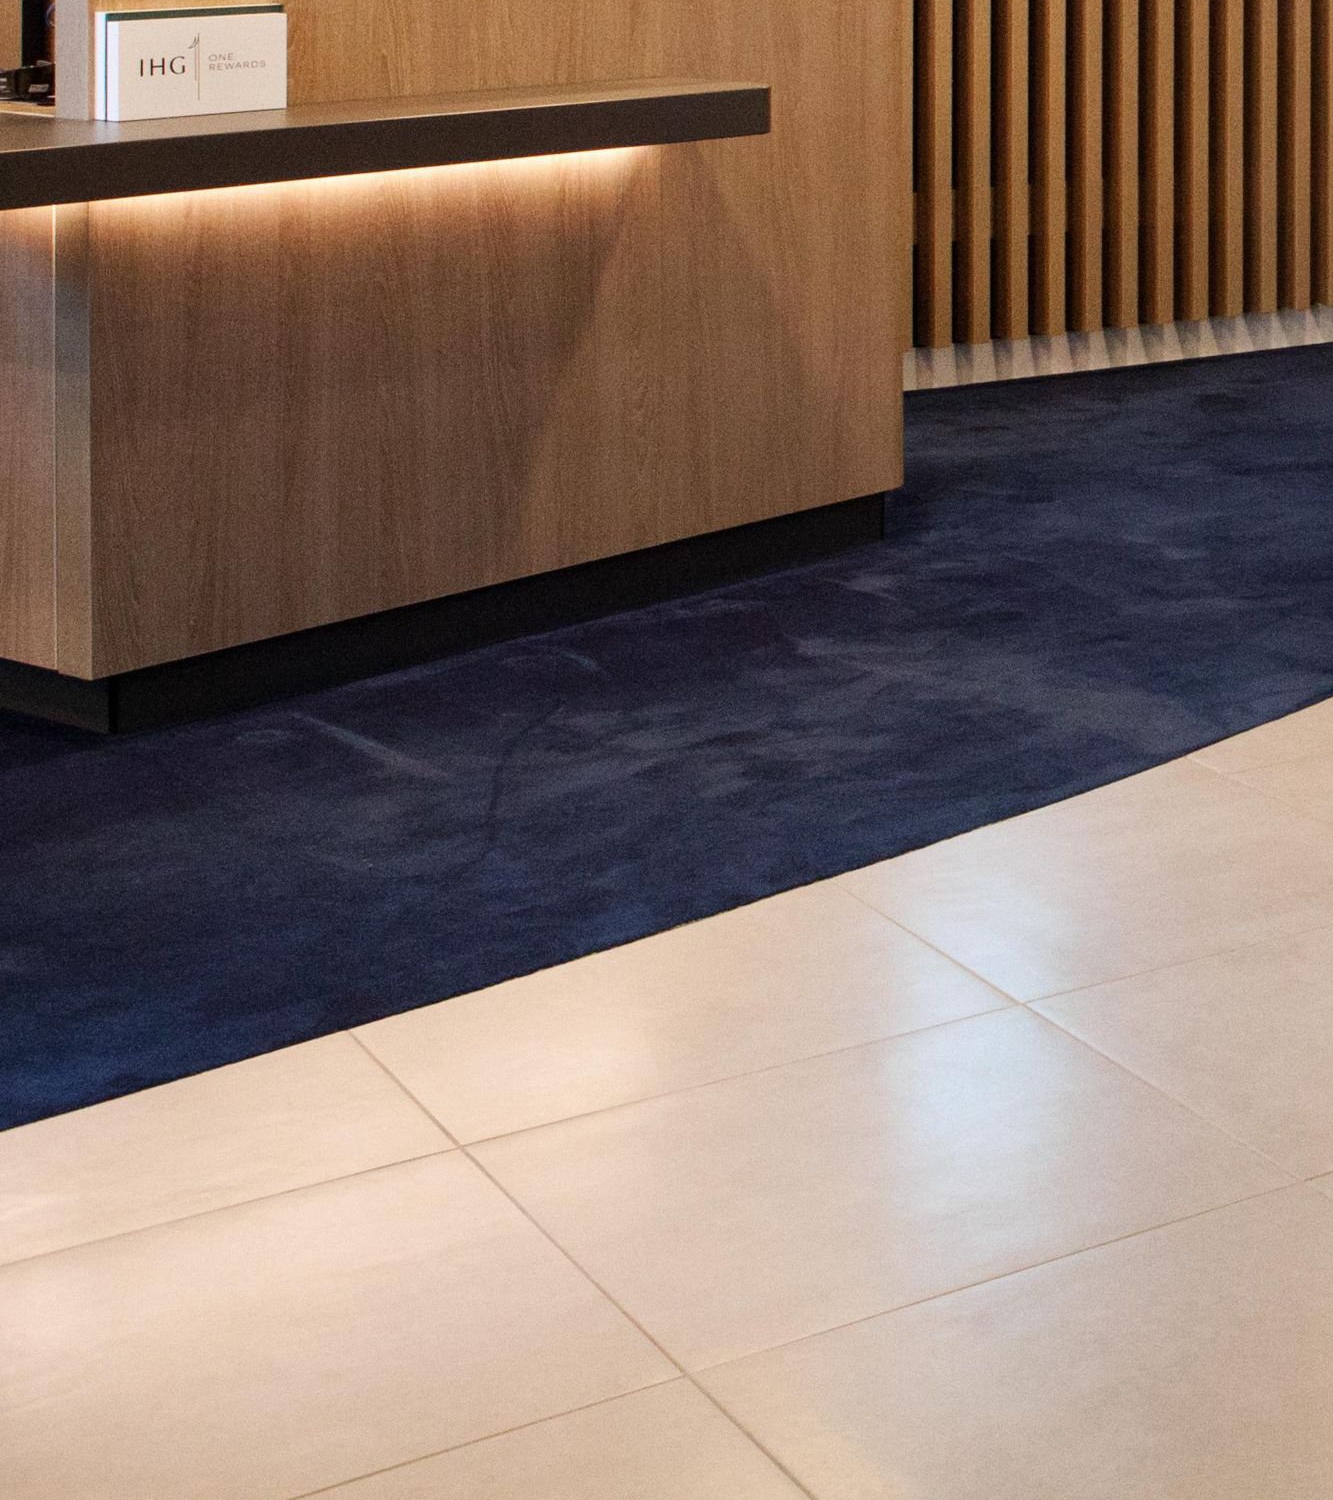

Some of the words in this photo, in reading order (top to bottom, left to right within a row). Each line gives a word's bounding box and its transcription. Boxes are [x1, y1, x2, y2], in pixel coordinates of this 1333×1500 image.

[209, 53, 234, 62] ONE
[140, 56, 186, 77] IHG
[209, 60, 266, 71] REWARDS
